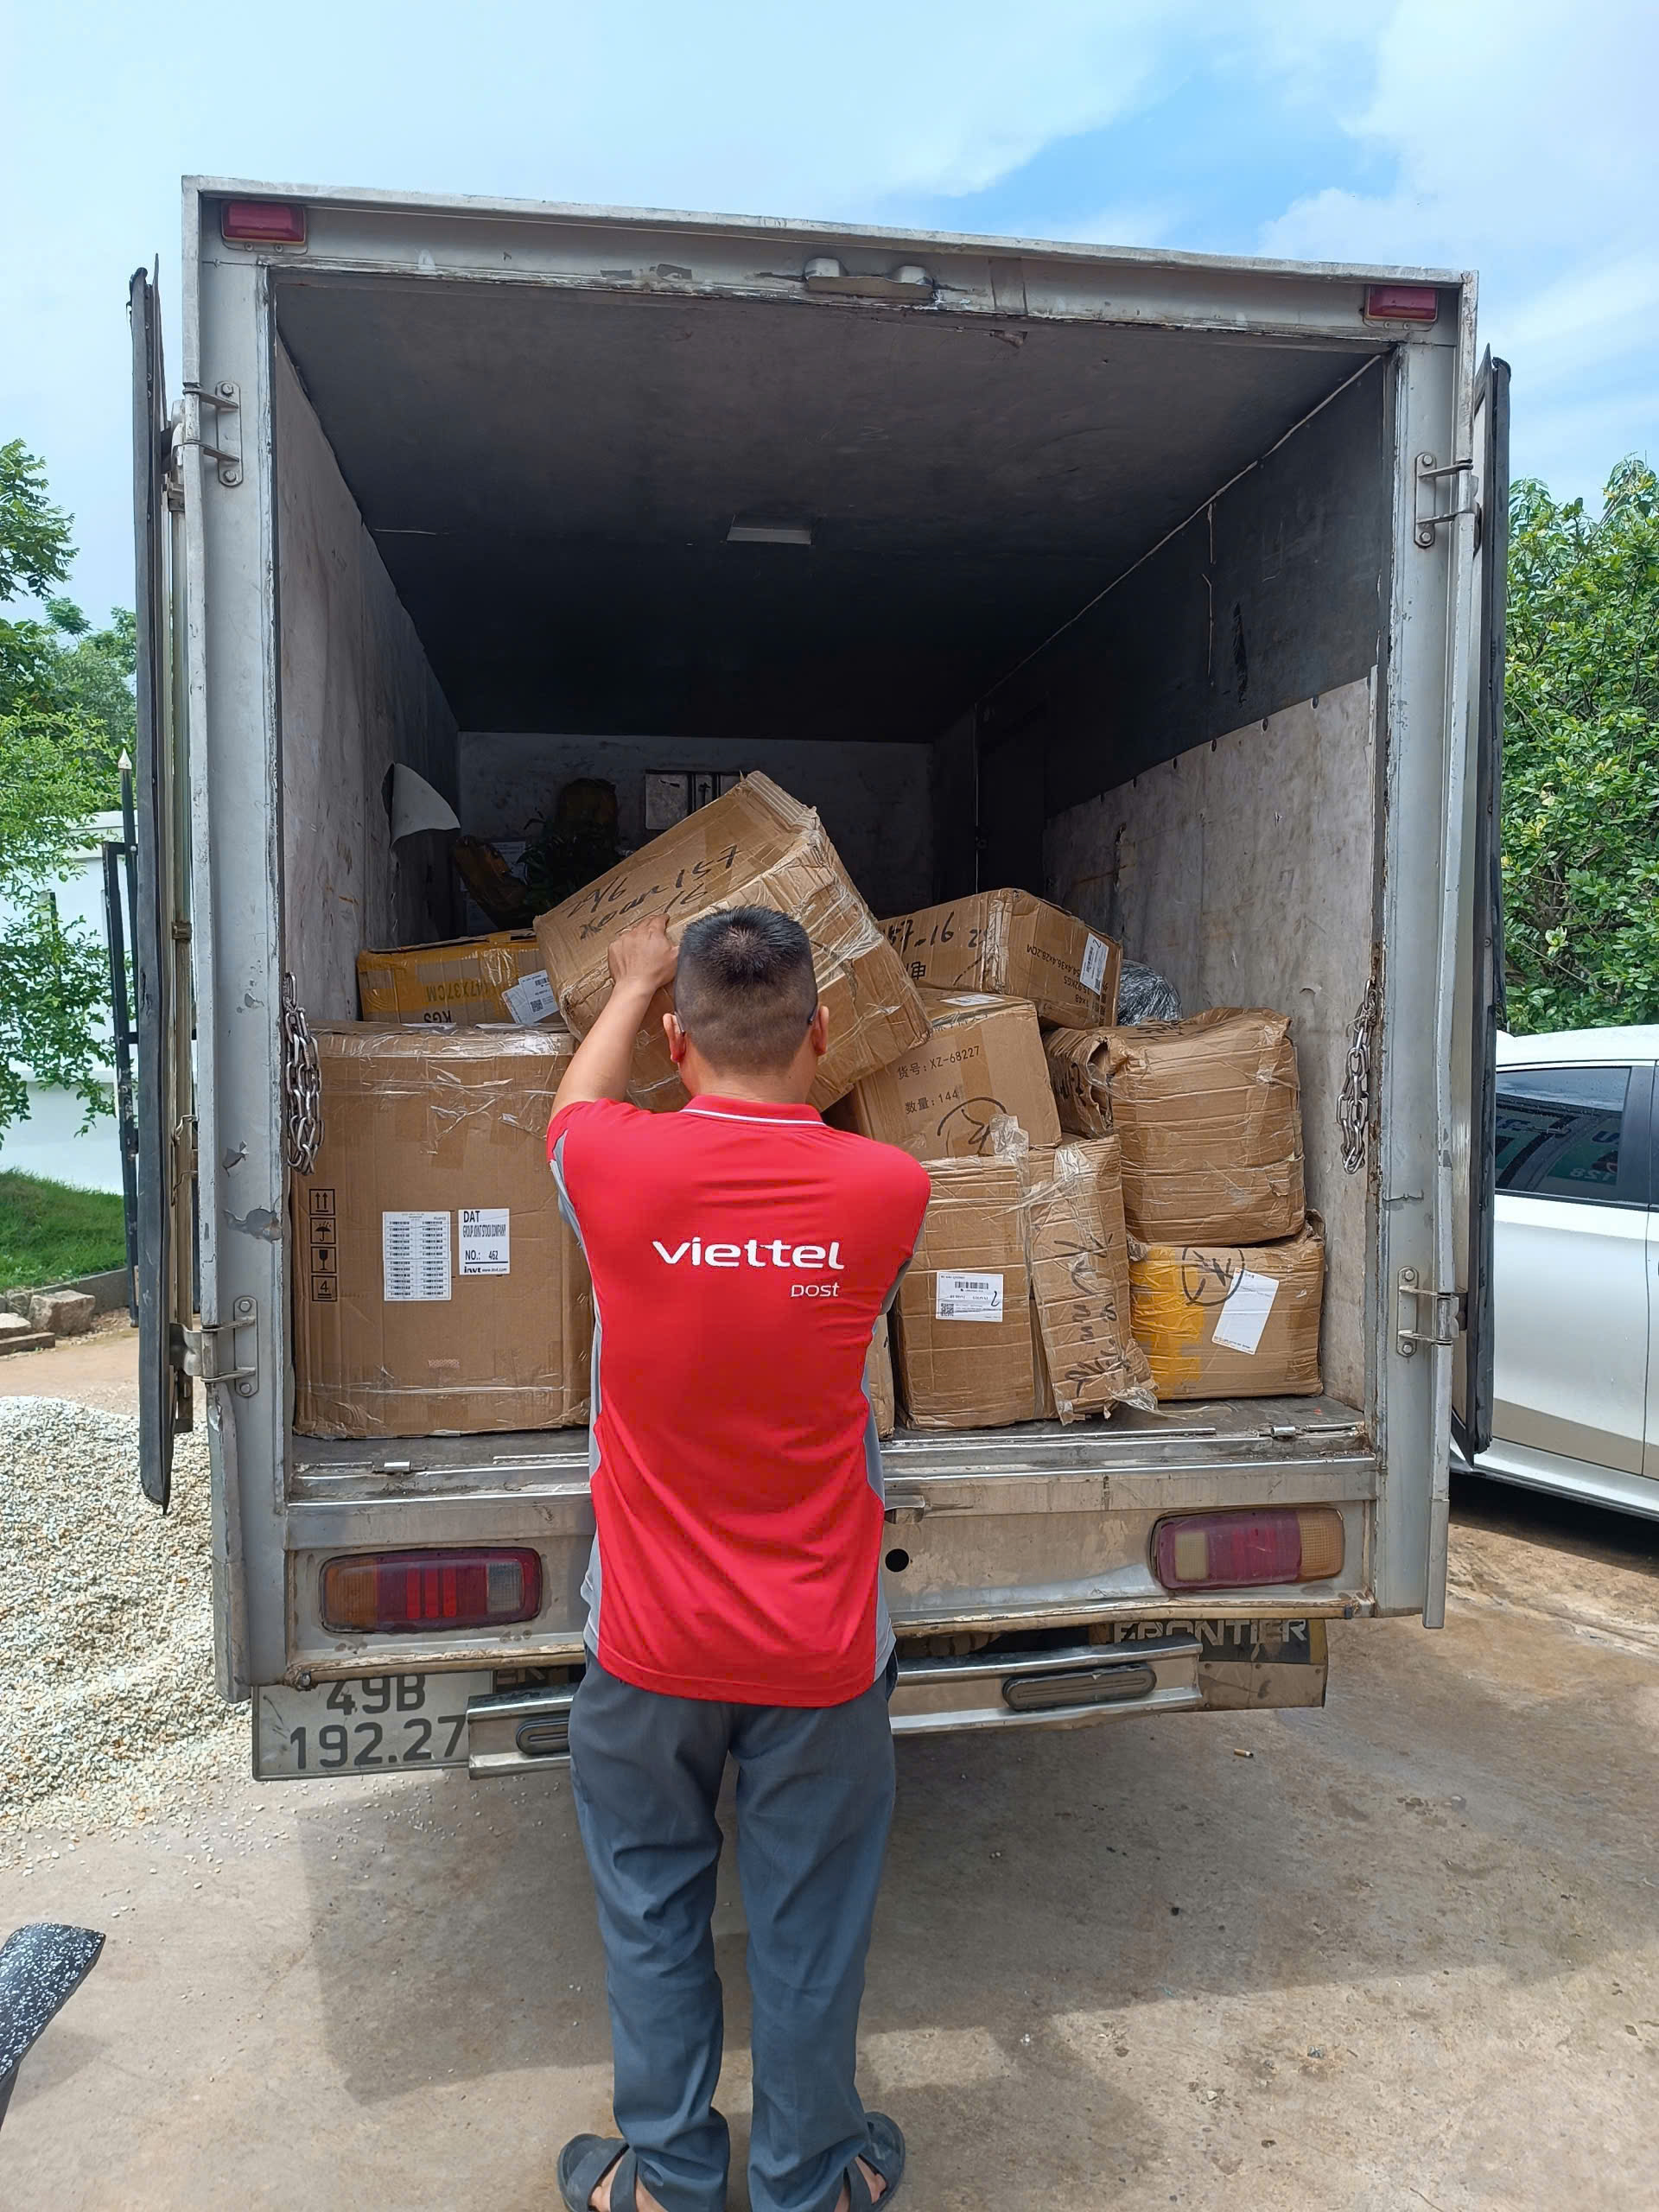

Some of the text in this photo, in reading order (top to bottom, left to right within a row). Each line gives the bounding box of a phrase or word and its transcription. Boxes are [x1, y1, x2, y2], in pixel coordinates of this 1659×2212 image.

[675, 845, 741, 888] 157
[423, 1010, 452, 1023] KGS
[463, 1211, 480, 1224] DAT
[652, 1236, 845, 1269] viettel
[320, 1280, 328, 1293] 4
[791, 1281, 841, 1298] post
[1114, 1618, 1307, 1647] FRONTIER
[327, 1673, 426, 1715] 49B
[290, 1714, 467, 1770] 192.27
